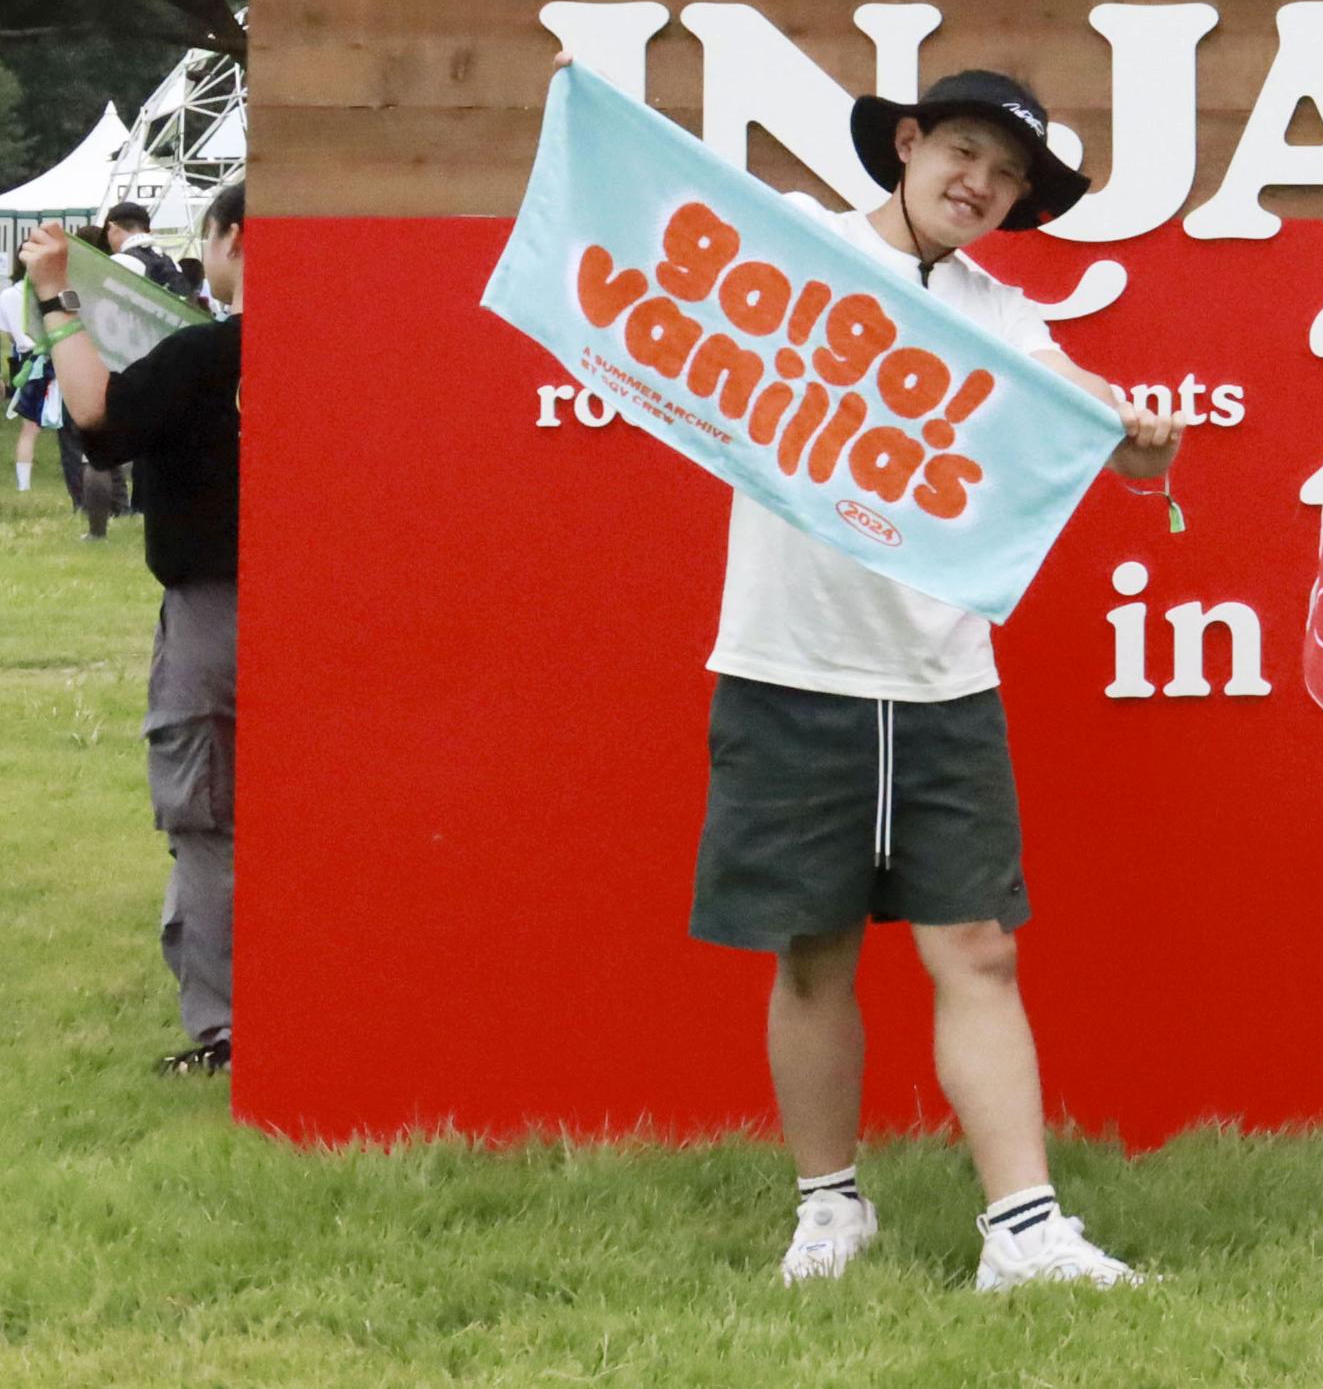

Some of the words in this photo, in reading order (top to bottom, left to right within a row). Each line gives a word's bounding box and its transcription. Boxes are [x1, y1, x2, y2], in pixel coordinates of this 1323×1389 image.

[577, 245, 985, 520] vanillas
[655, 202, 996, 451] go!go!
[594, 354, 663, 404] SUMMER
[663, 401, 733, 445] ARCHIVE
[843, 500, 894, 542] 2024
[1105, 560, 1273, 698] in
